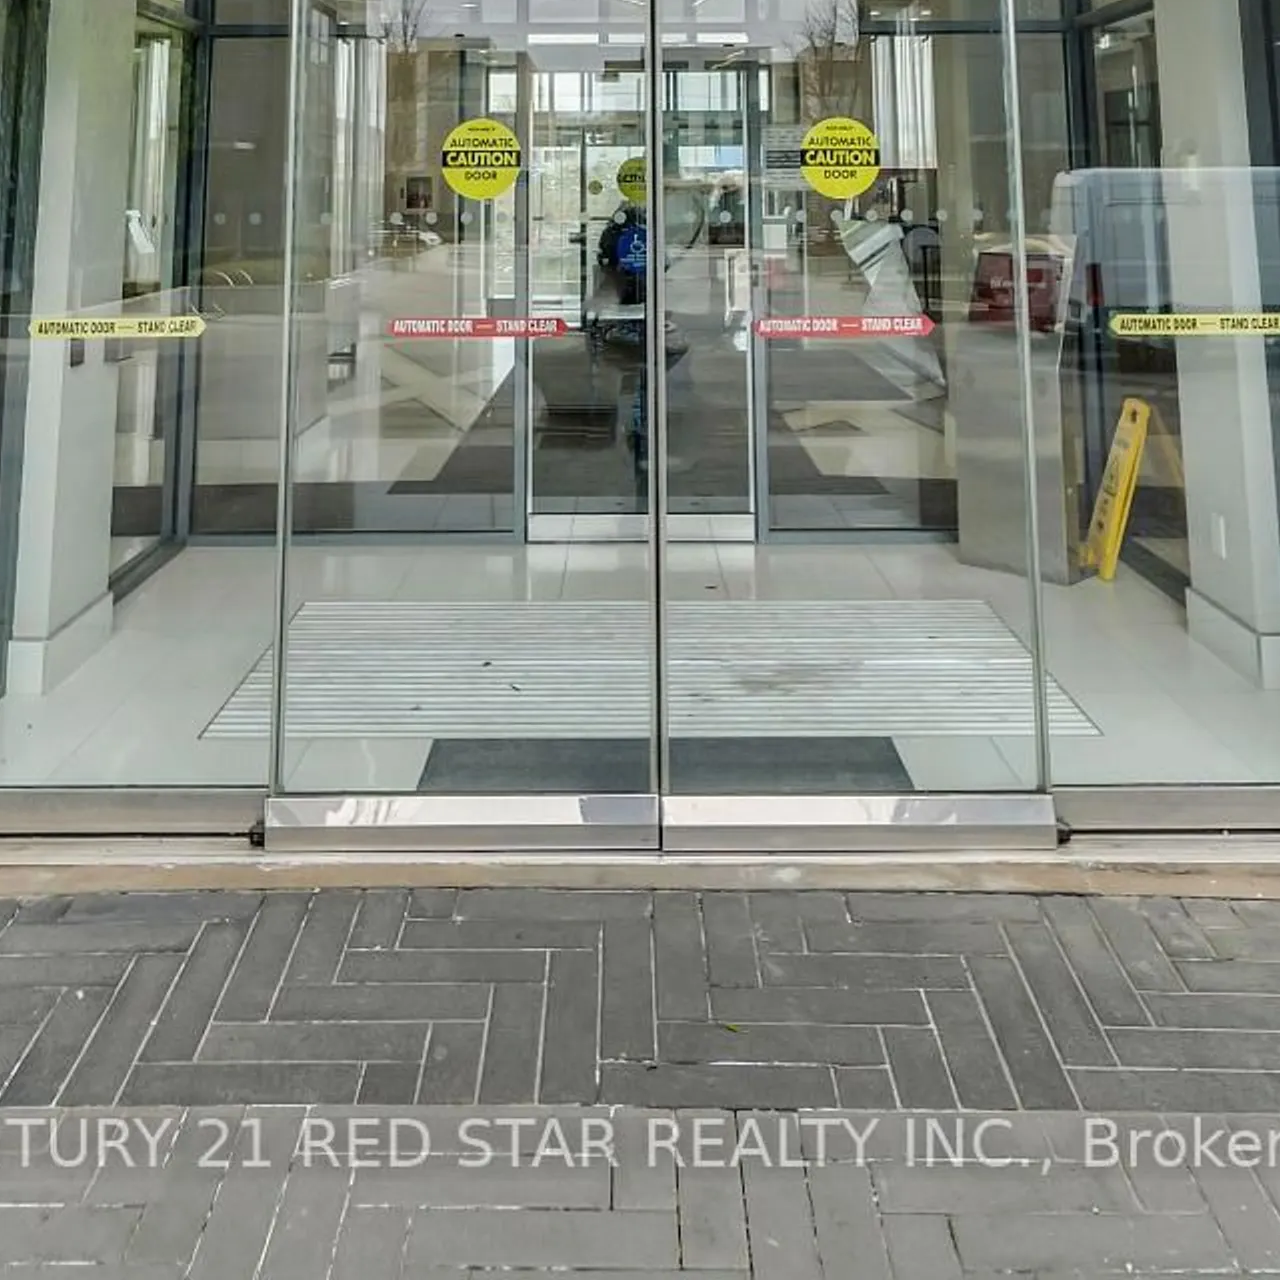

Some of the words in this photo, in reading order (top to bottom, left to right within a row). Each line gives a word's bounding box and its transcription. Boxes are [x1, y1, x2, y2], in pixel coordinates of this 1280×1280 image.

[450, 137, 514, 148] AUTOMATIC
[808, 136, 872, 147] AUTOMATIC
[446, 151, 517, 166] CAUTION
[805, 150, 876, 165] CAUTION
[463, 170, 498, 181] DOOR
[823, 169, 858, 180] DOOR
[37, 321, 88, 336] AUTOMATIC
[89, 321, 116, 335] DOOR
[137, 320, 168, 334] STAND
[167, 319, 198, 334] CLEAR
[393, 319, 446, 334] AUTOMATIC
[447, 319, 474, 334] DOOR
[495, 319, 526, 333] STAND
[527, 319, 558, 333] CLEAR
[758, 319, 811, 333] AUTOMATIC
[812, 318, 839, 332] DOOR
[860, 317, 891, 331] STAND
[892, 317, 924, 331] CLEAR
[1119, 317, 1172, 331] AUTOMATIC
[1173, 317, 1199, 330] DOOR
[1219, 317, 1250, 330] STAND
[1250, 316, 1280, 329] CLEAR
